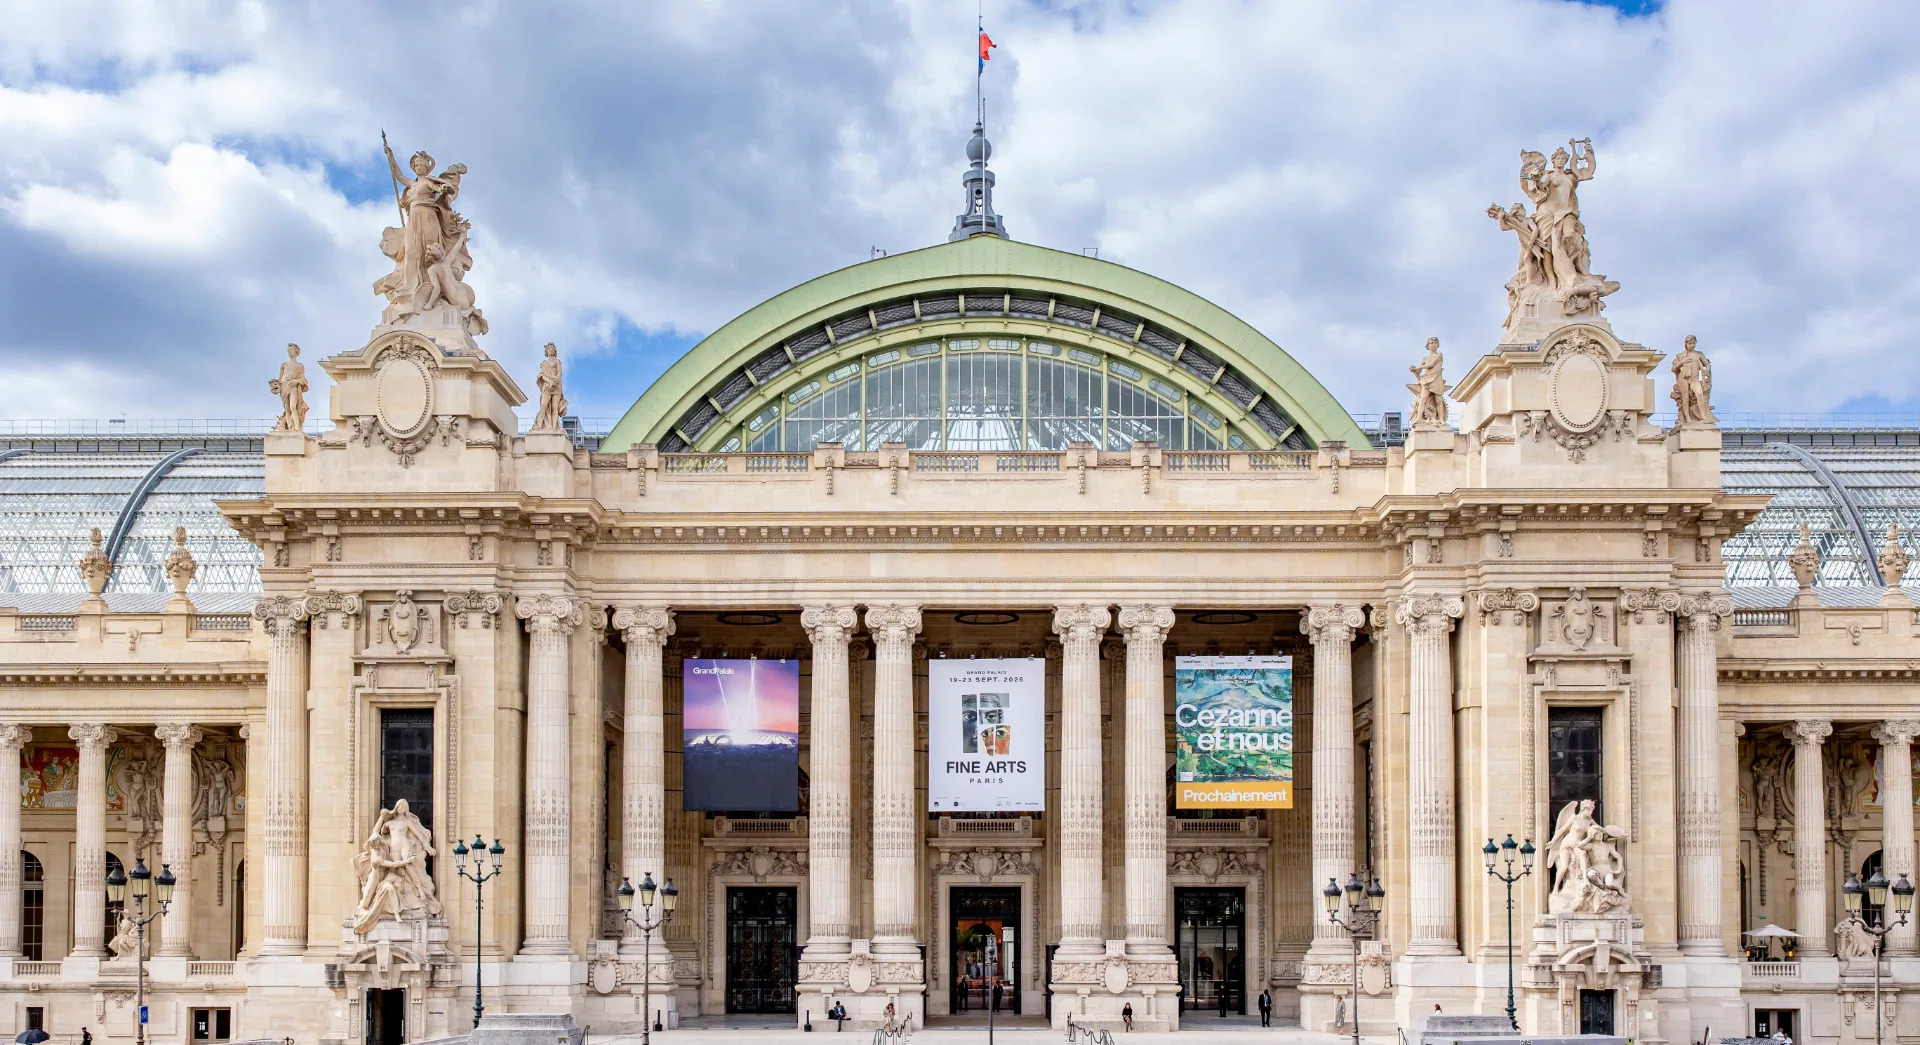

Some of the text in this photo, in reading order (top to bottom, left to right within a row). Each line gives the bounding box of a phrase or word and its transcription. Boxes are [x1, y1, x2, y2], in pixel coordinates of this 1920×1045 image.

[693, 667, 735, 675] GrandPalais
[1176, 704, 1292, 728] Cezanne
[1197, 727, 1292, 751] et nous
[946, 761, 1027, 773] FINE ARTS
[1183, 789, 1287, 802] Prochainement
